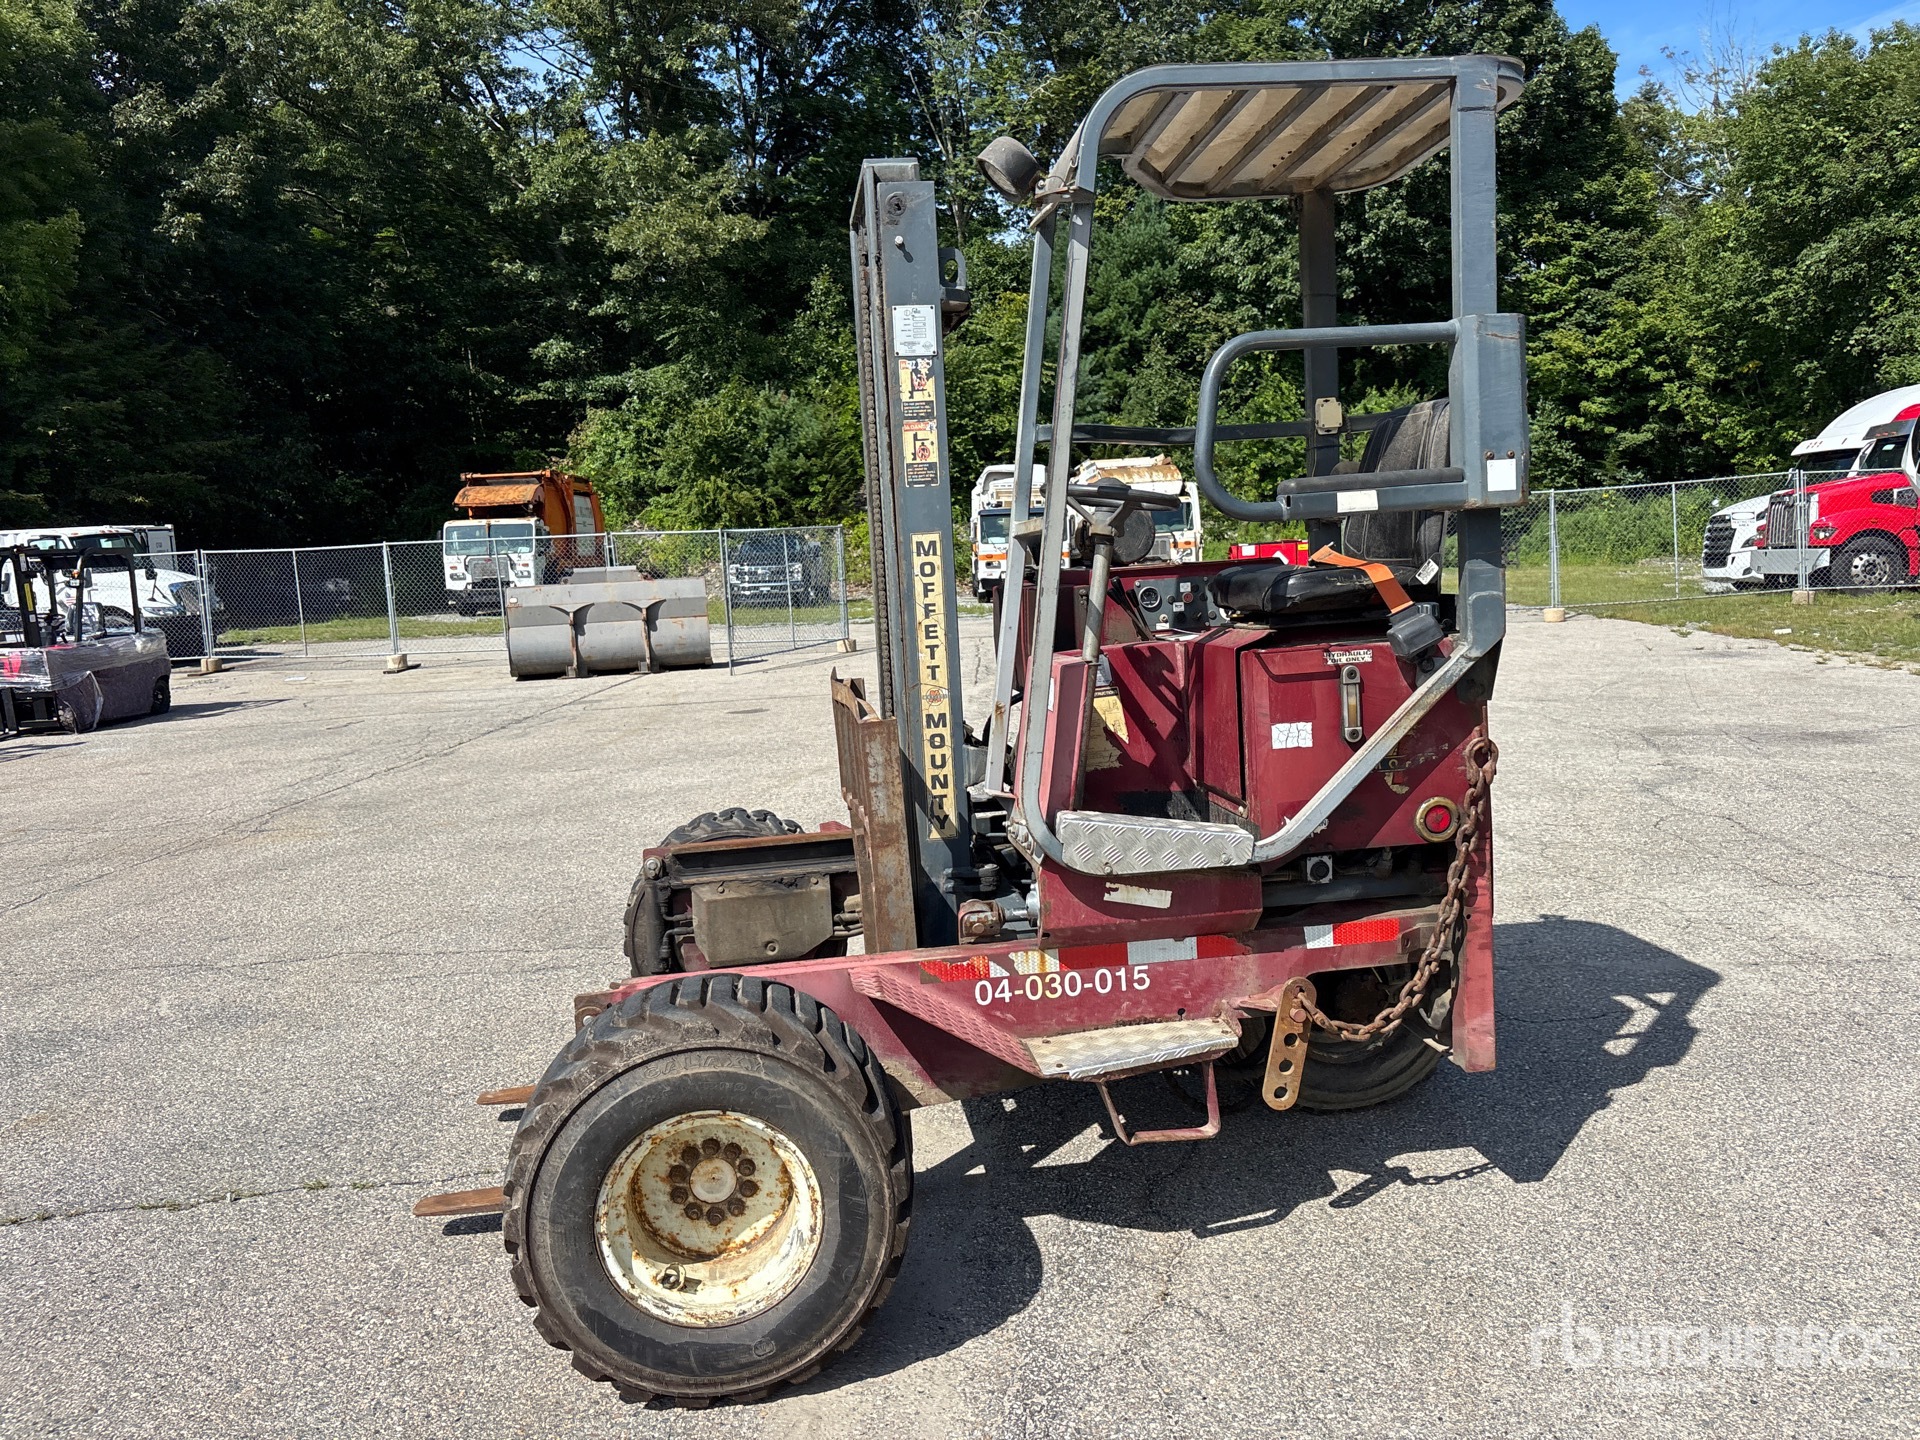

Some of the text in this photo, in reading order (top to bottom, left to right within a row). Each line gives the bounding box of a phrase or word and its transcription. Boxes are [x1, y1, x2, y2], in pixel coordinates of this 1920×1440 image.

[915, 540, 941, 681] MOFFETT
[1325, 649, 1372, 658] HYDRAULIC
[925, 712, 949, 830] MOUNTY
[974, 964, 1151, 1006] 04-030-015
[643, 1054, 765, 1079] GALAXY
